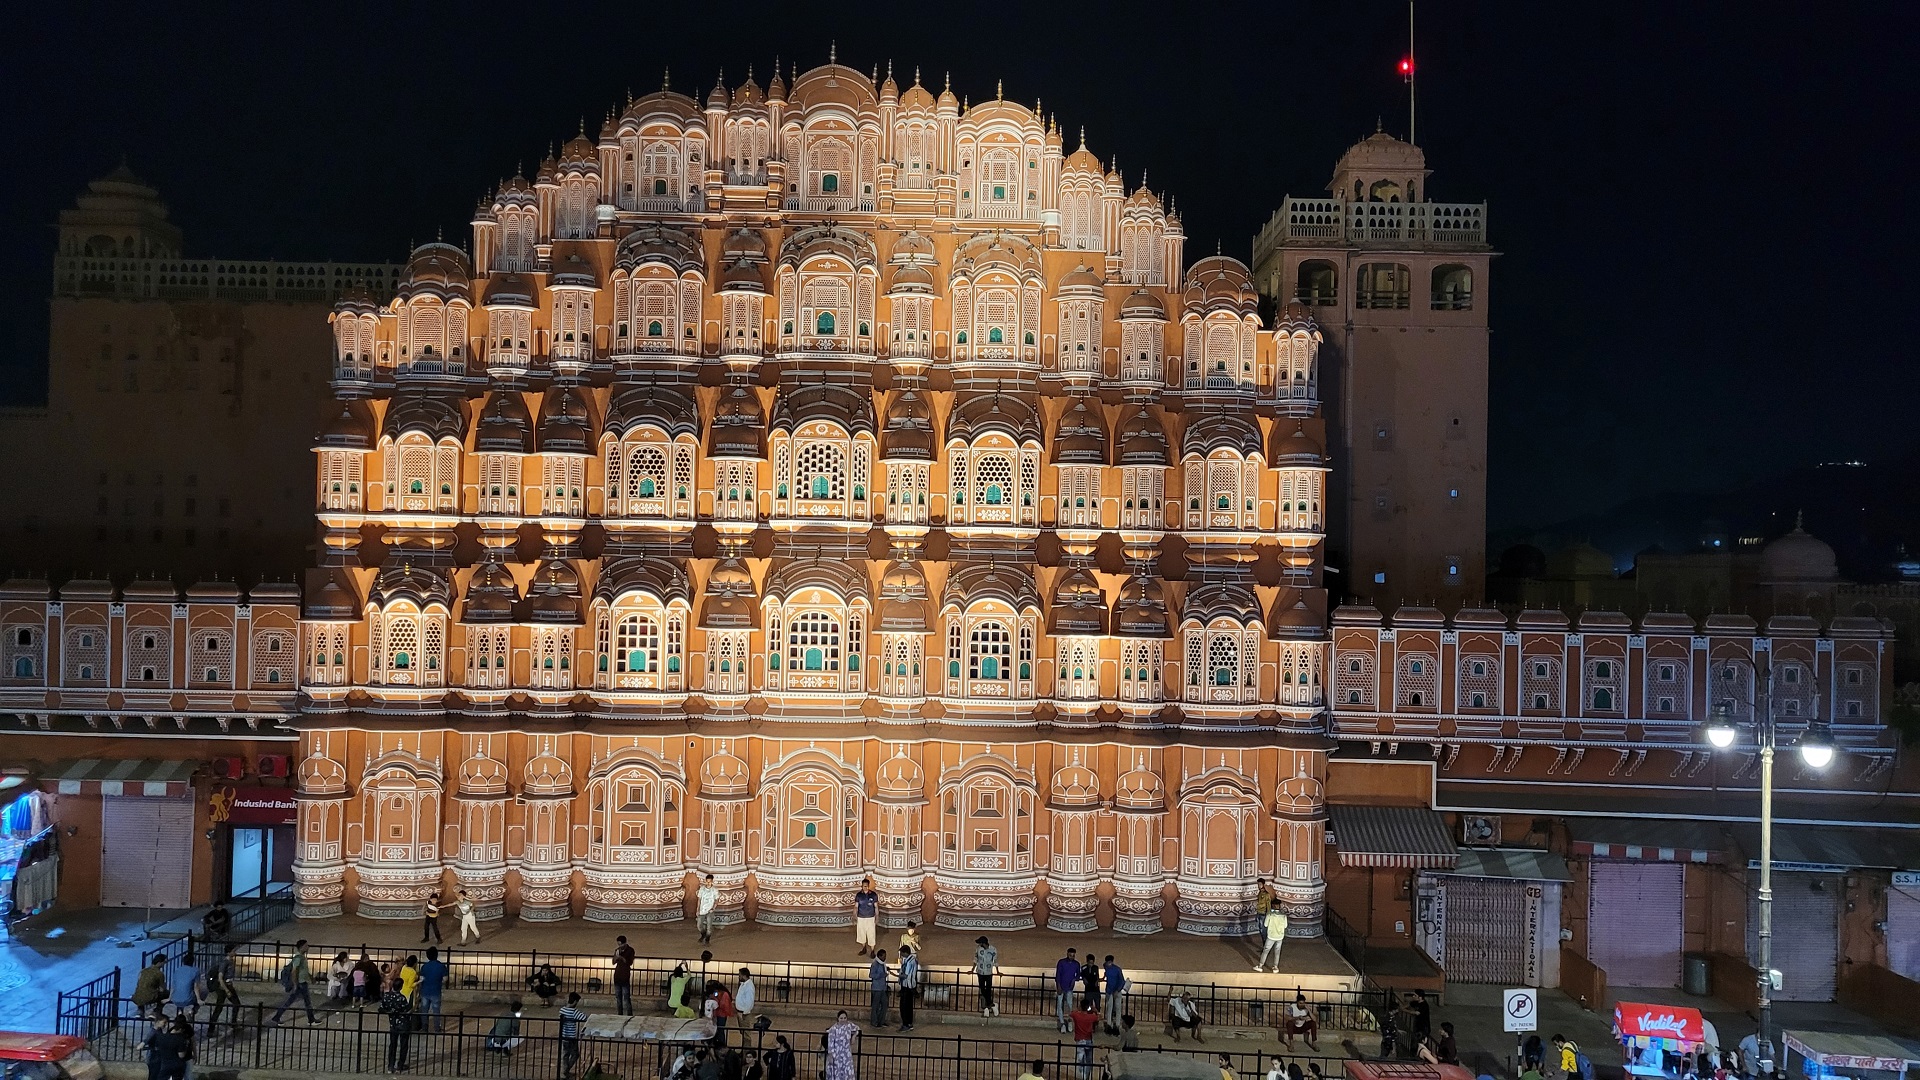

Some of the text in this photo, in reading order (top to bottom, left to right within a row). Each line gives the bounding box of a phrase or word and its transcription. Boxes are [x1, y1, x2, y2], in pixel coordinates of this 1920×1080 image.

[234, 799, 298, 809] IndusInd Bank
[1896, 875, 1912, 883] S.S.
[1526, 886, 1541, 898] GB
[1528, 900, 1537, 978] INTERNATIONAL
[1637, 1011, 1687, 1038] Vadilal
